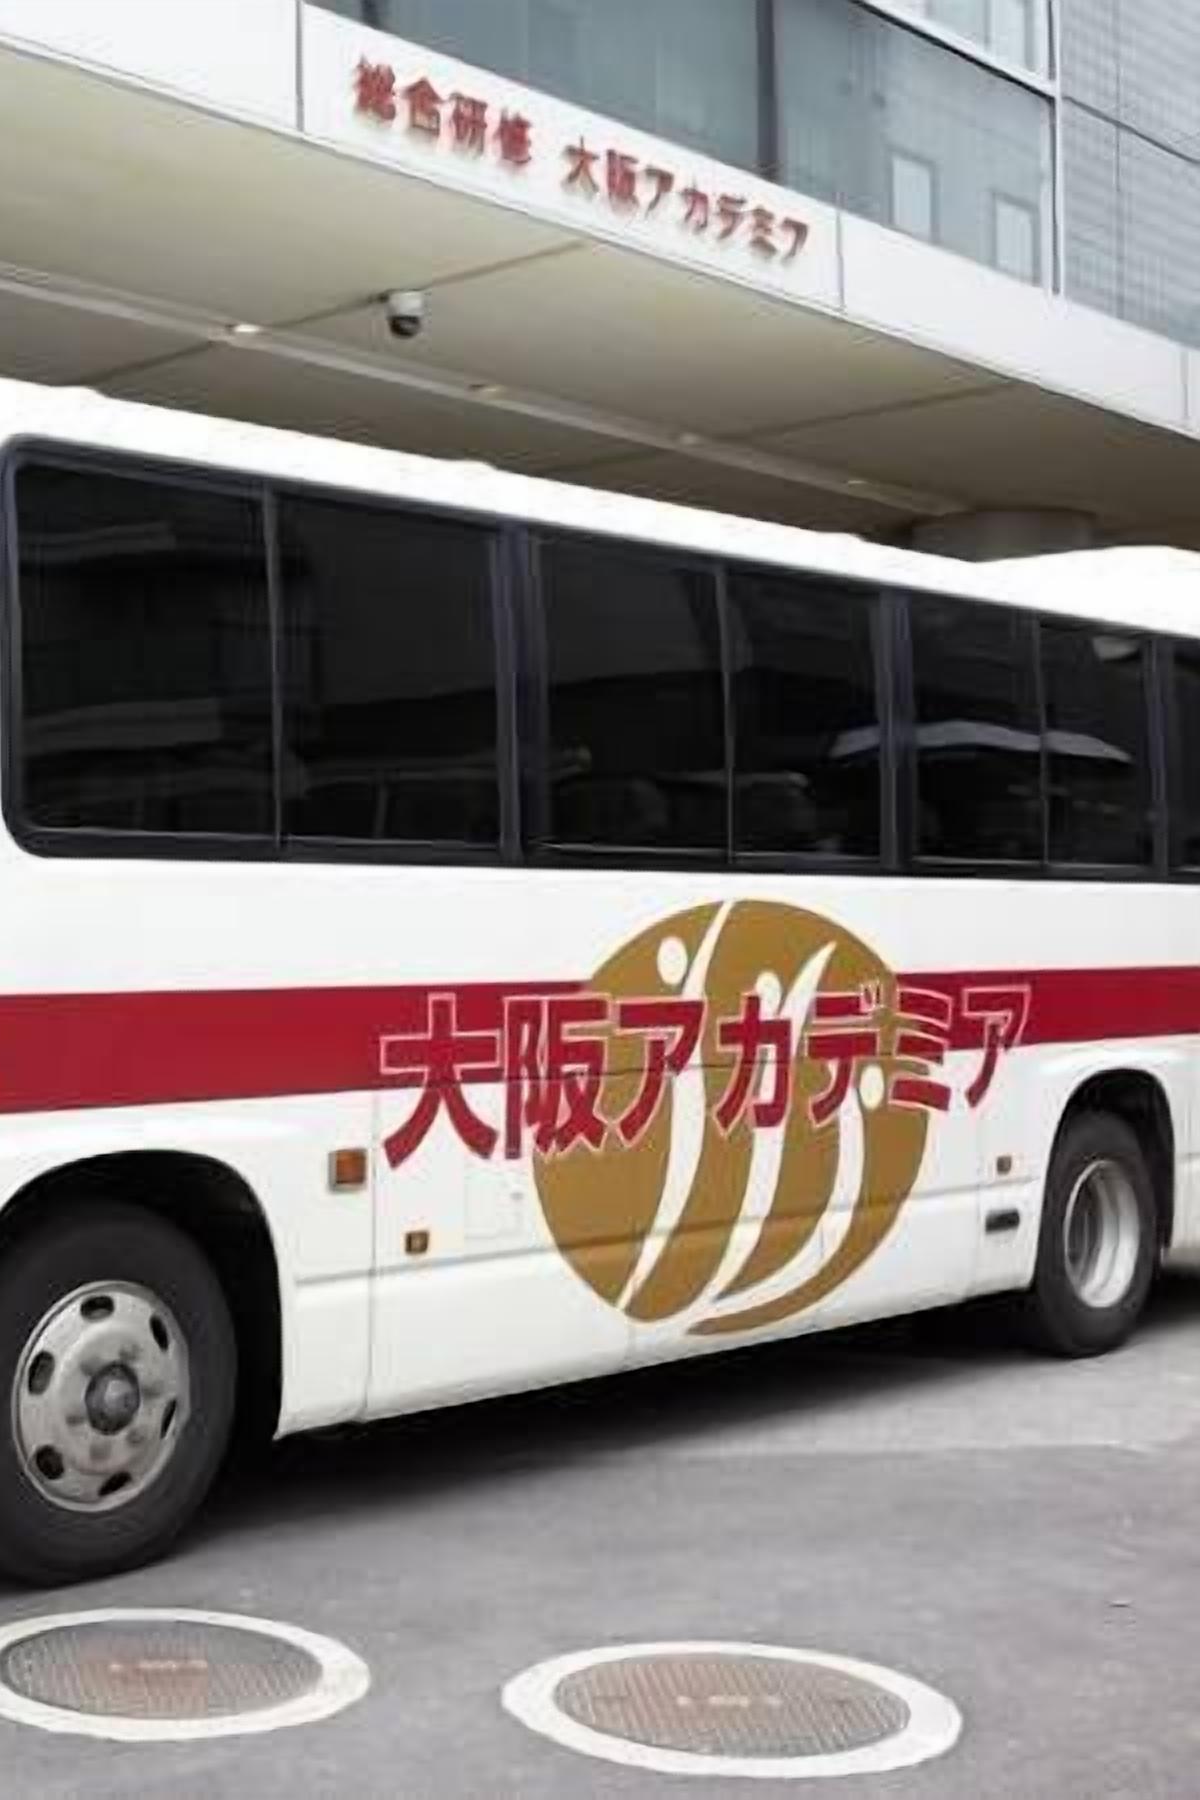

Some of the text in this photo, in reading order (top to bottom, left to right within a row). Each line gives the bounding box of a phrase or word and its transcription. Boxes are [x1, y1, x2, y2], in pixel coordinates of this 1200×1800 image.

[378, 982, 1032, 1169] 大阪アカデミア
